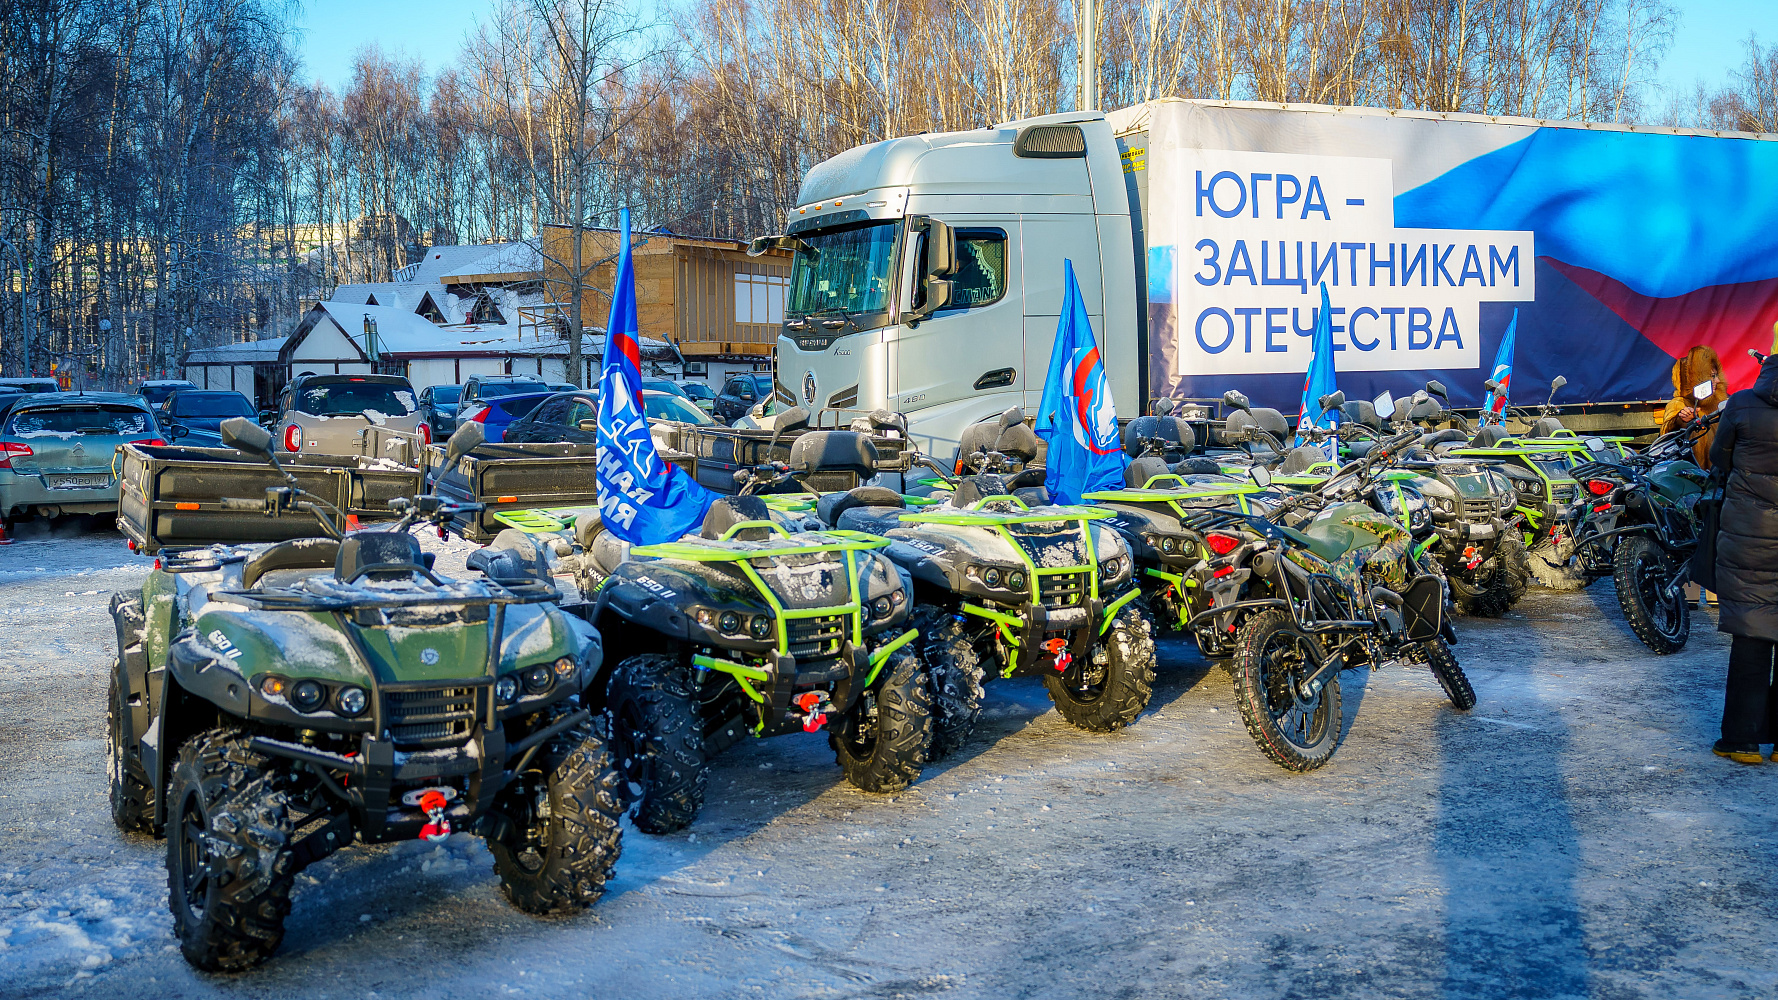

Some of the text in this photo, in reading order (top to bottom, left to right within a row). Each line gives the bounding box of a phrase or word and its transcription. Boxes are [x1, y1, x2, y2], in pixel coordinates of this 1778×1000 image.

[1195, 170, 1331, 220] ЮГРА
[1194, 239, 1519, 294] ЗАЩИТНИКАМ
[1195, 307, 1464, 354] ОТЕЧЕСТВА
[636, 576, 664, 592] 650
[208, 629, 232, 651] 650
